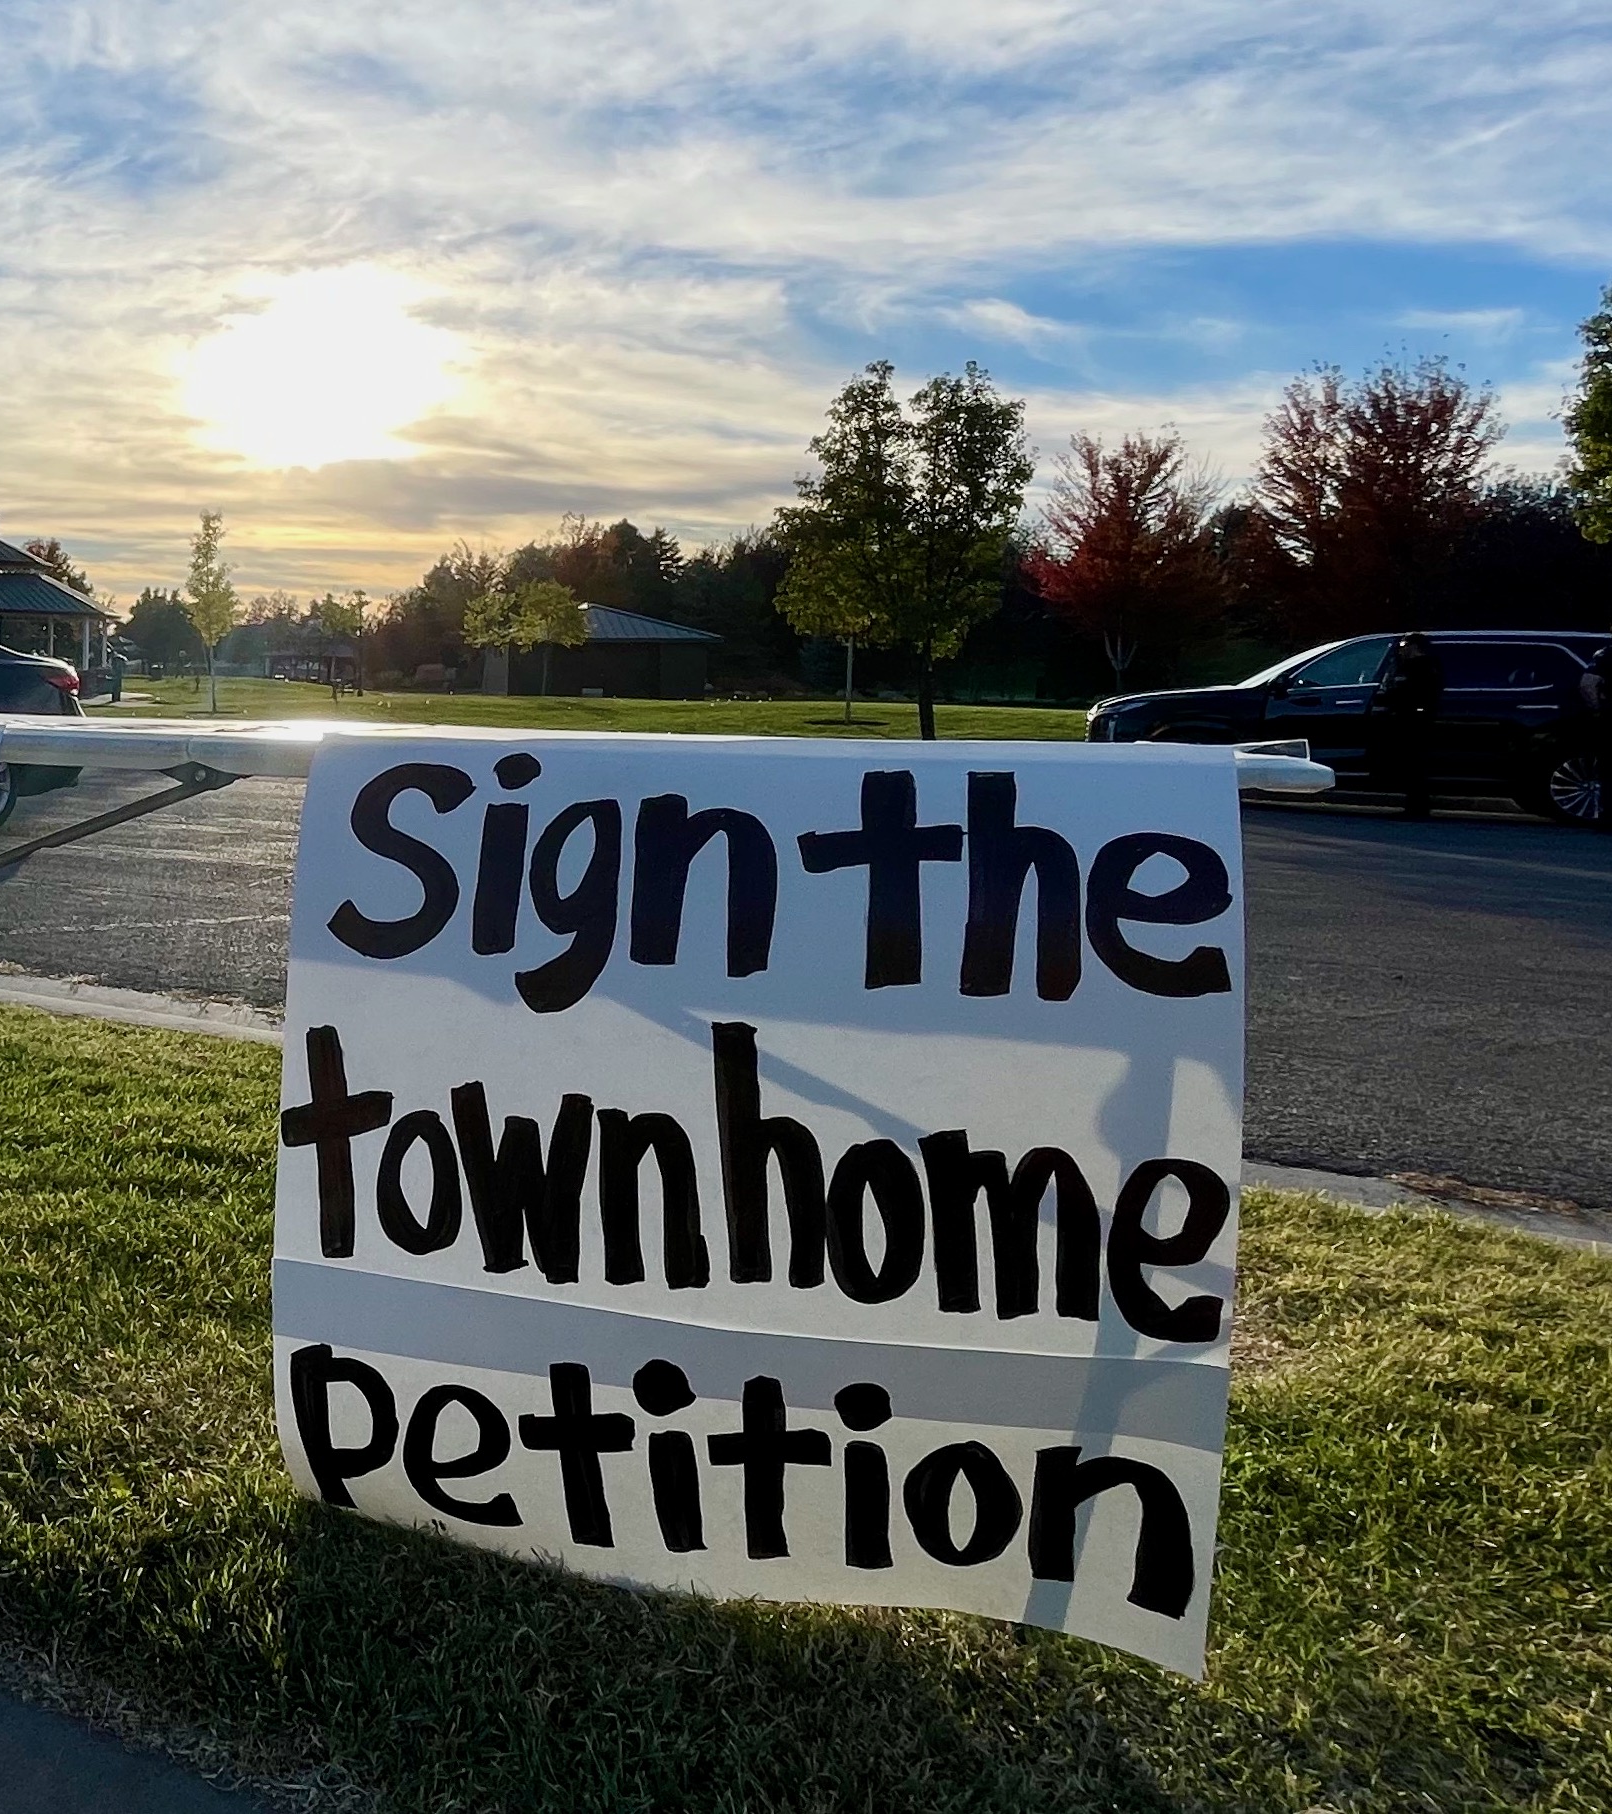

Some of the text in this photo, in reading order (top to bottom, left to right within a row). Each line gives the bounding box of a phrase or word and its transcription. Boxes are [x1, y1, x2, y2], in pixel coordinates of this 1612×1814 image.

[326, 752, 1233, 1013] Sign the
[280, 1022, 1225, 1343] townhome
